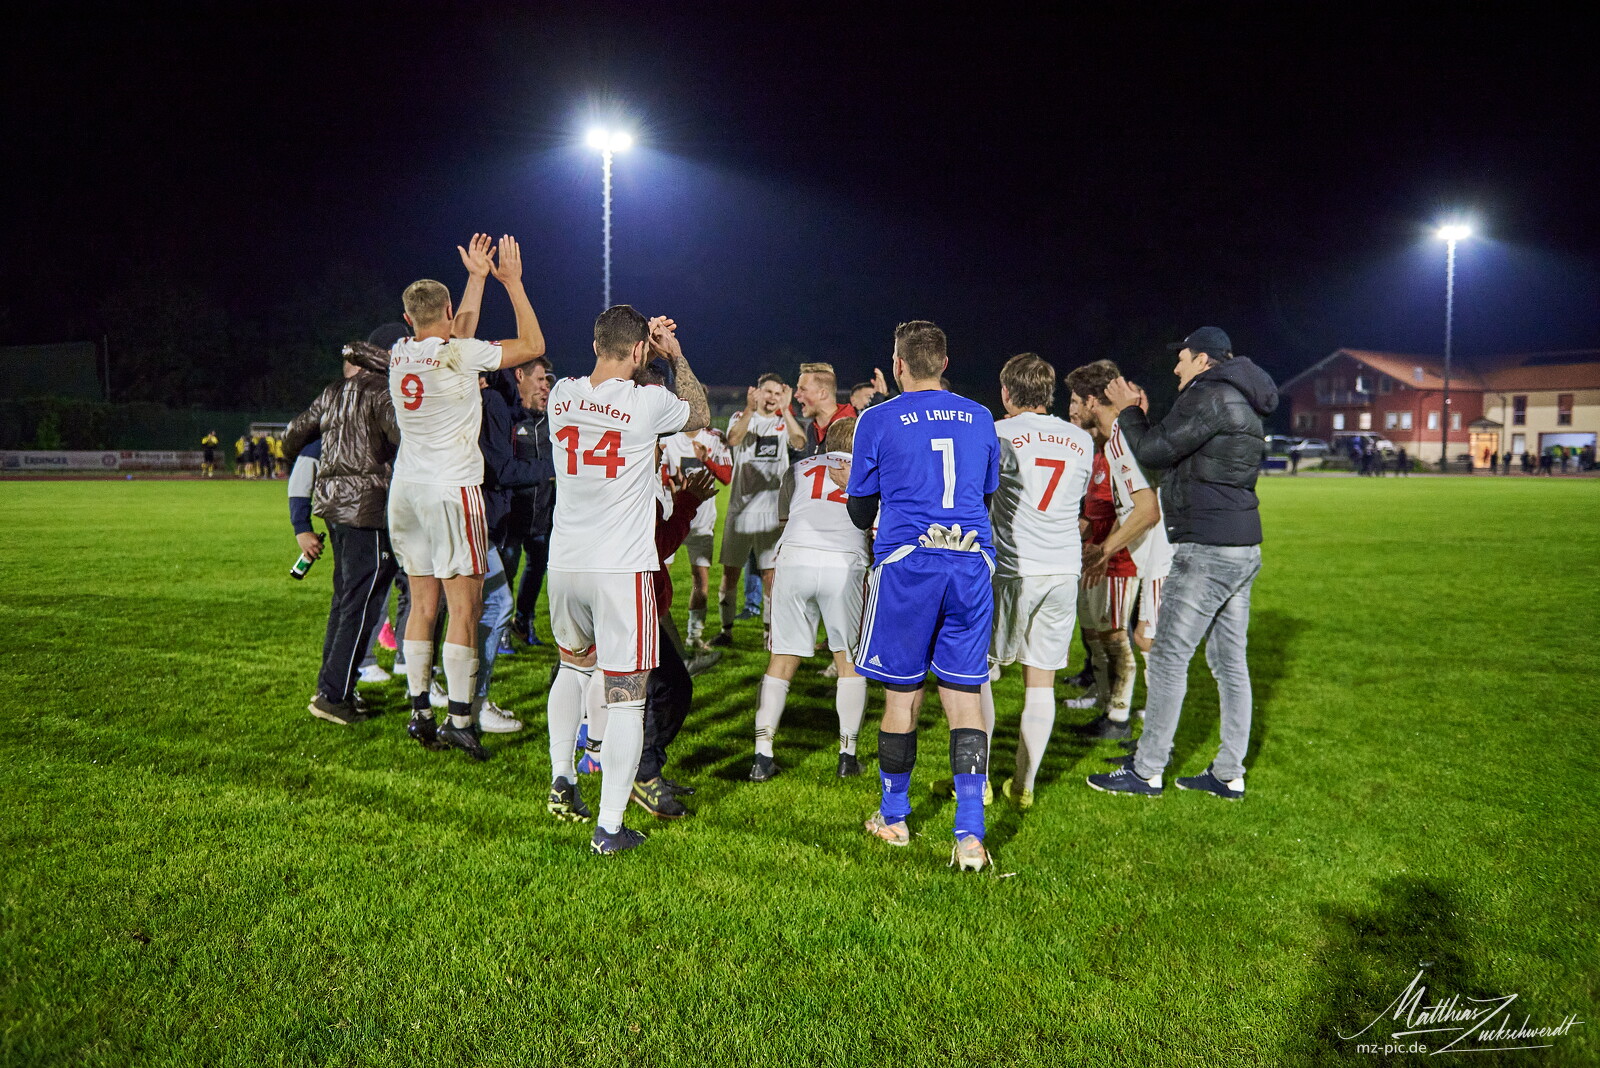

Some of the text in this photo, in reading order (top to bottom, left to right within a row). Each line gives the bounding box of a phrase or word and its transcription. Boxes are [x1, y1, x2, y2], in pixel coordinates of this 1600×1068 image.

[401, 373, 424, 411] 9
[554, 400, 631, 424] SV Laufen
[926, 410, 973, 425] LAUFEN
[555, 425, 626, 479] 14
[1012, 431, 1085, 456] SV Laufen
[826, 456, 852, 464] Lau
[931, 438, 956, 509] 1
[1035, 457, 1066, 512] 7
